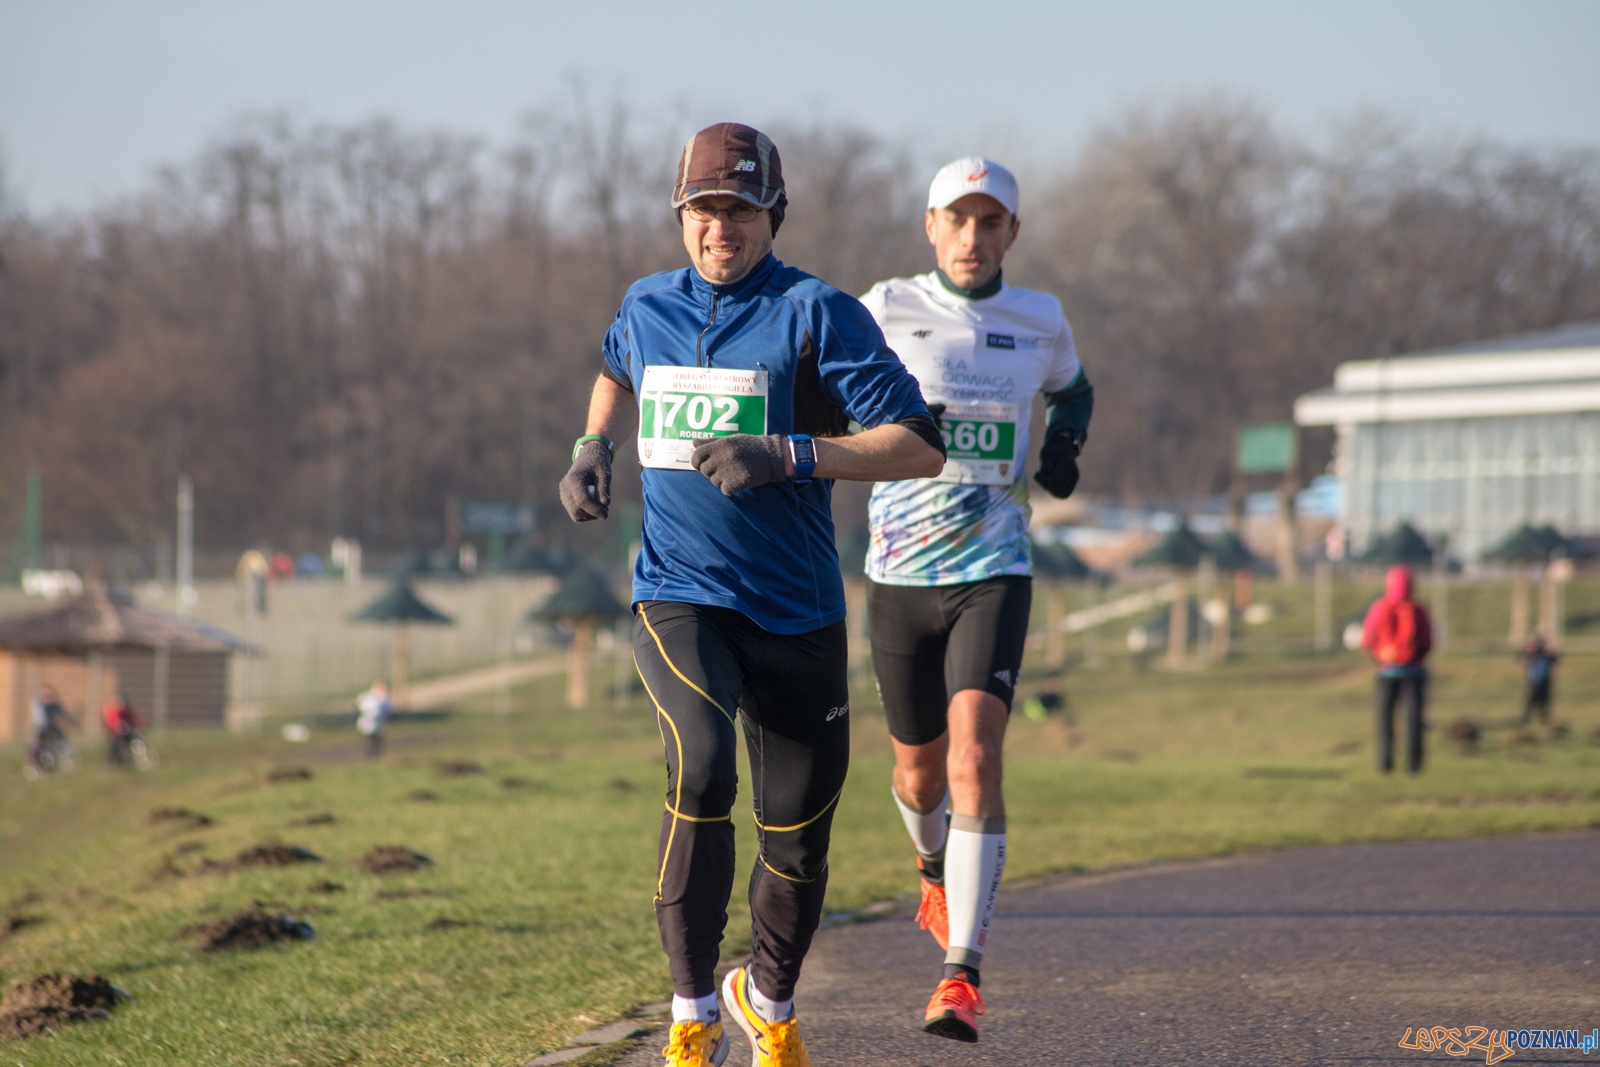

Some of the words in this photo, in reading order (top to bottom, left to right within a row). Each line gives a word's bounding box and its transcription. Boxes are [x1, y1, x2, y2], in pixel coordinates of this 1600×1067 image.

[679, 373, 698, 381] BIEG
[942, 371, 1015, 388] ODWAGA
[672, 382, 712, 391] RYSZARDA
[662, 394, 739, 431] 702
[679, 430, 715, 439] ROBERT
[947, 450, 980, 459] DOMINIK
